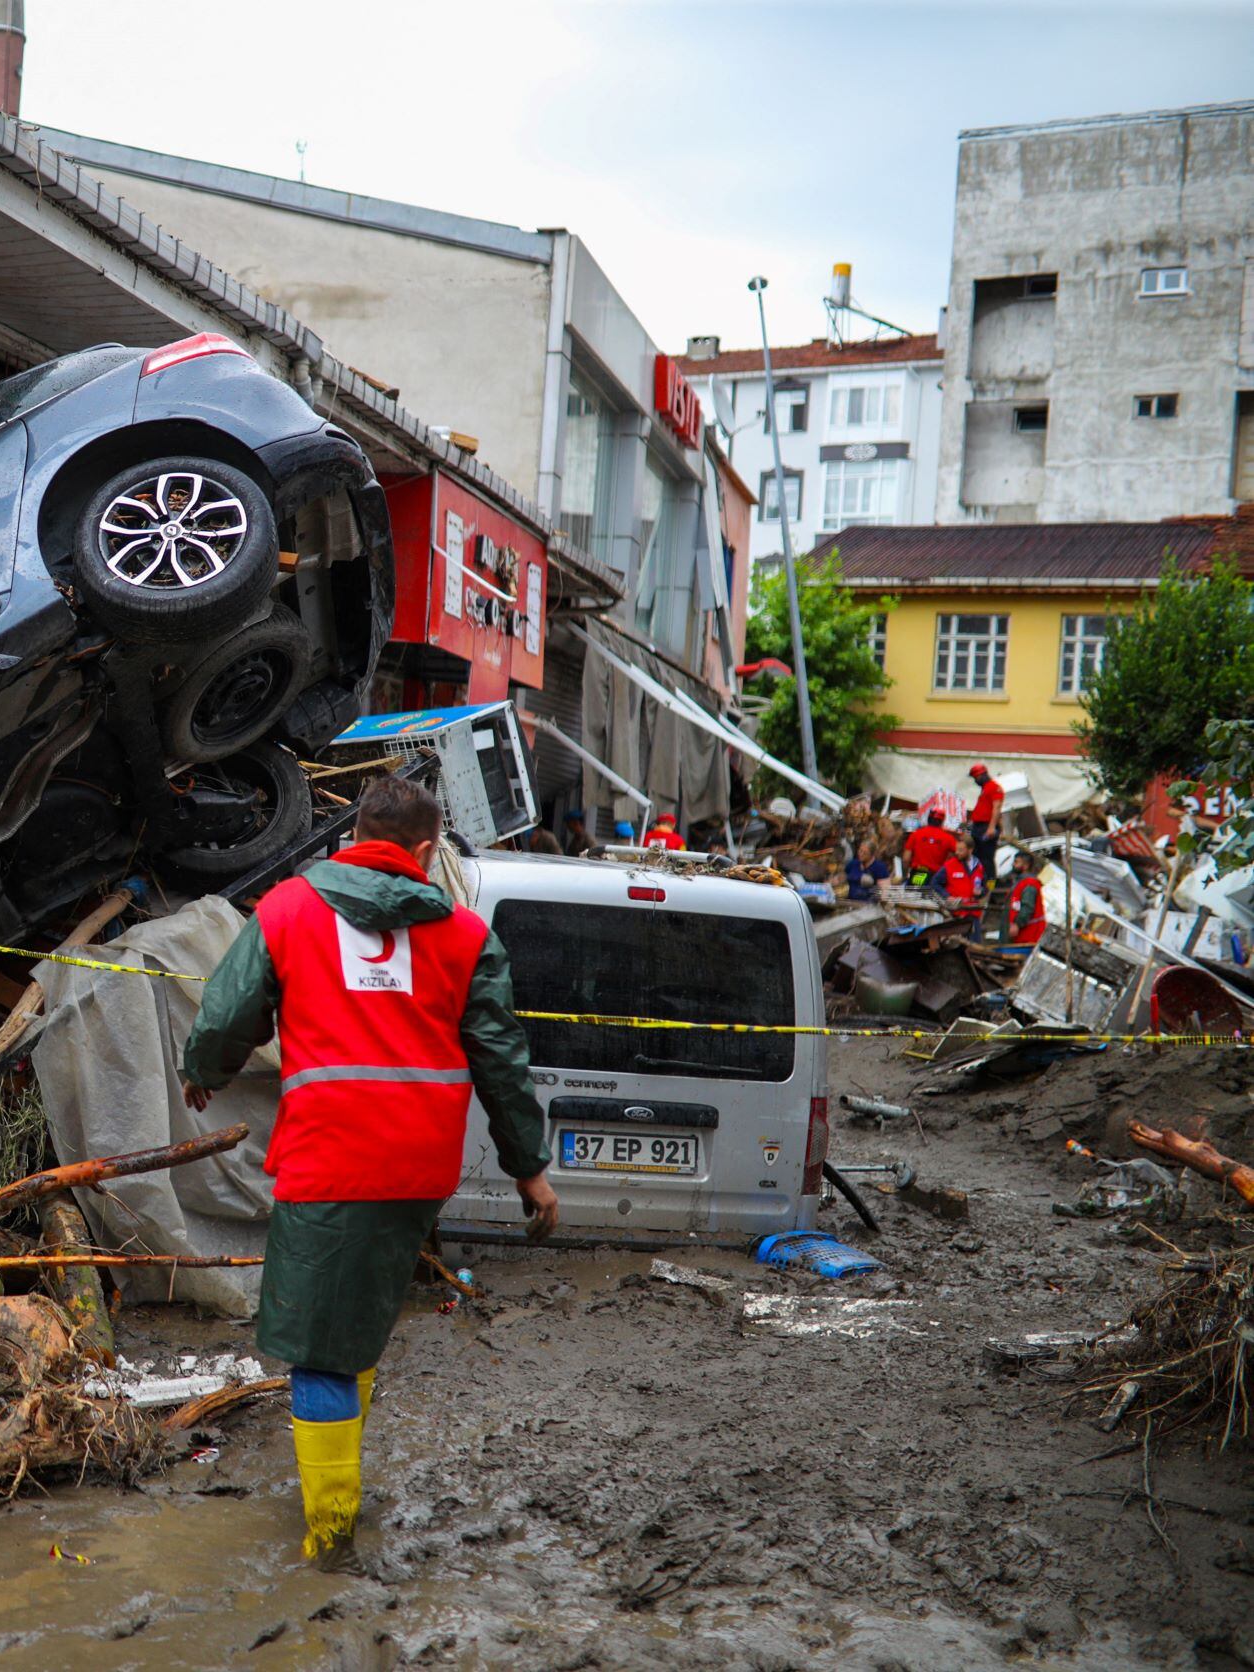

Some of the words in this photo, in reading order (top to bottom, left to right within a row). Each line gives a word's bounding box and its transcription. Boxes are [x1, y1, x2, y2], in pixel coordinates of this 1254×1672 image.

[575, 1136, 604, 1160] 37
[613, 1138, 642, 1162] EP
[651, 1139, 691, 1165] 921
